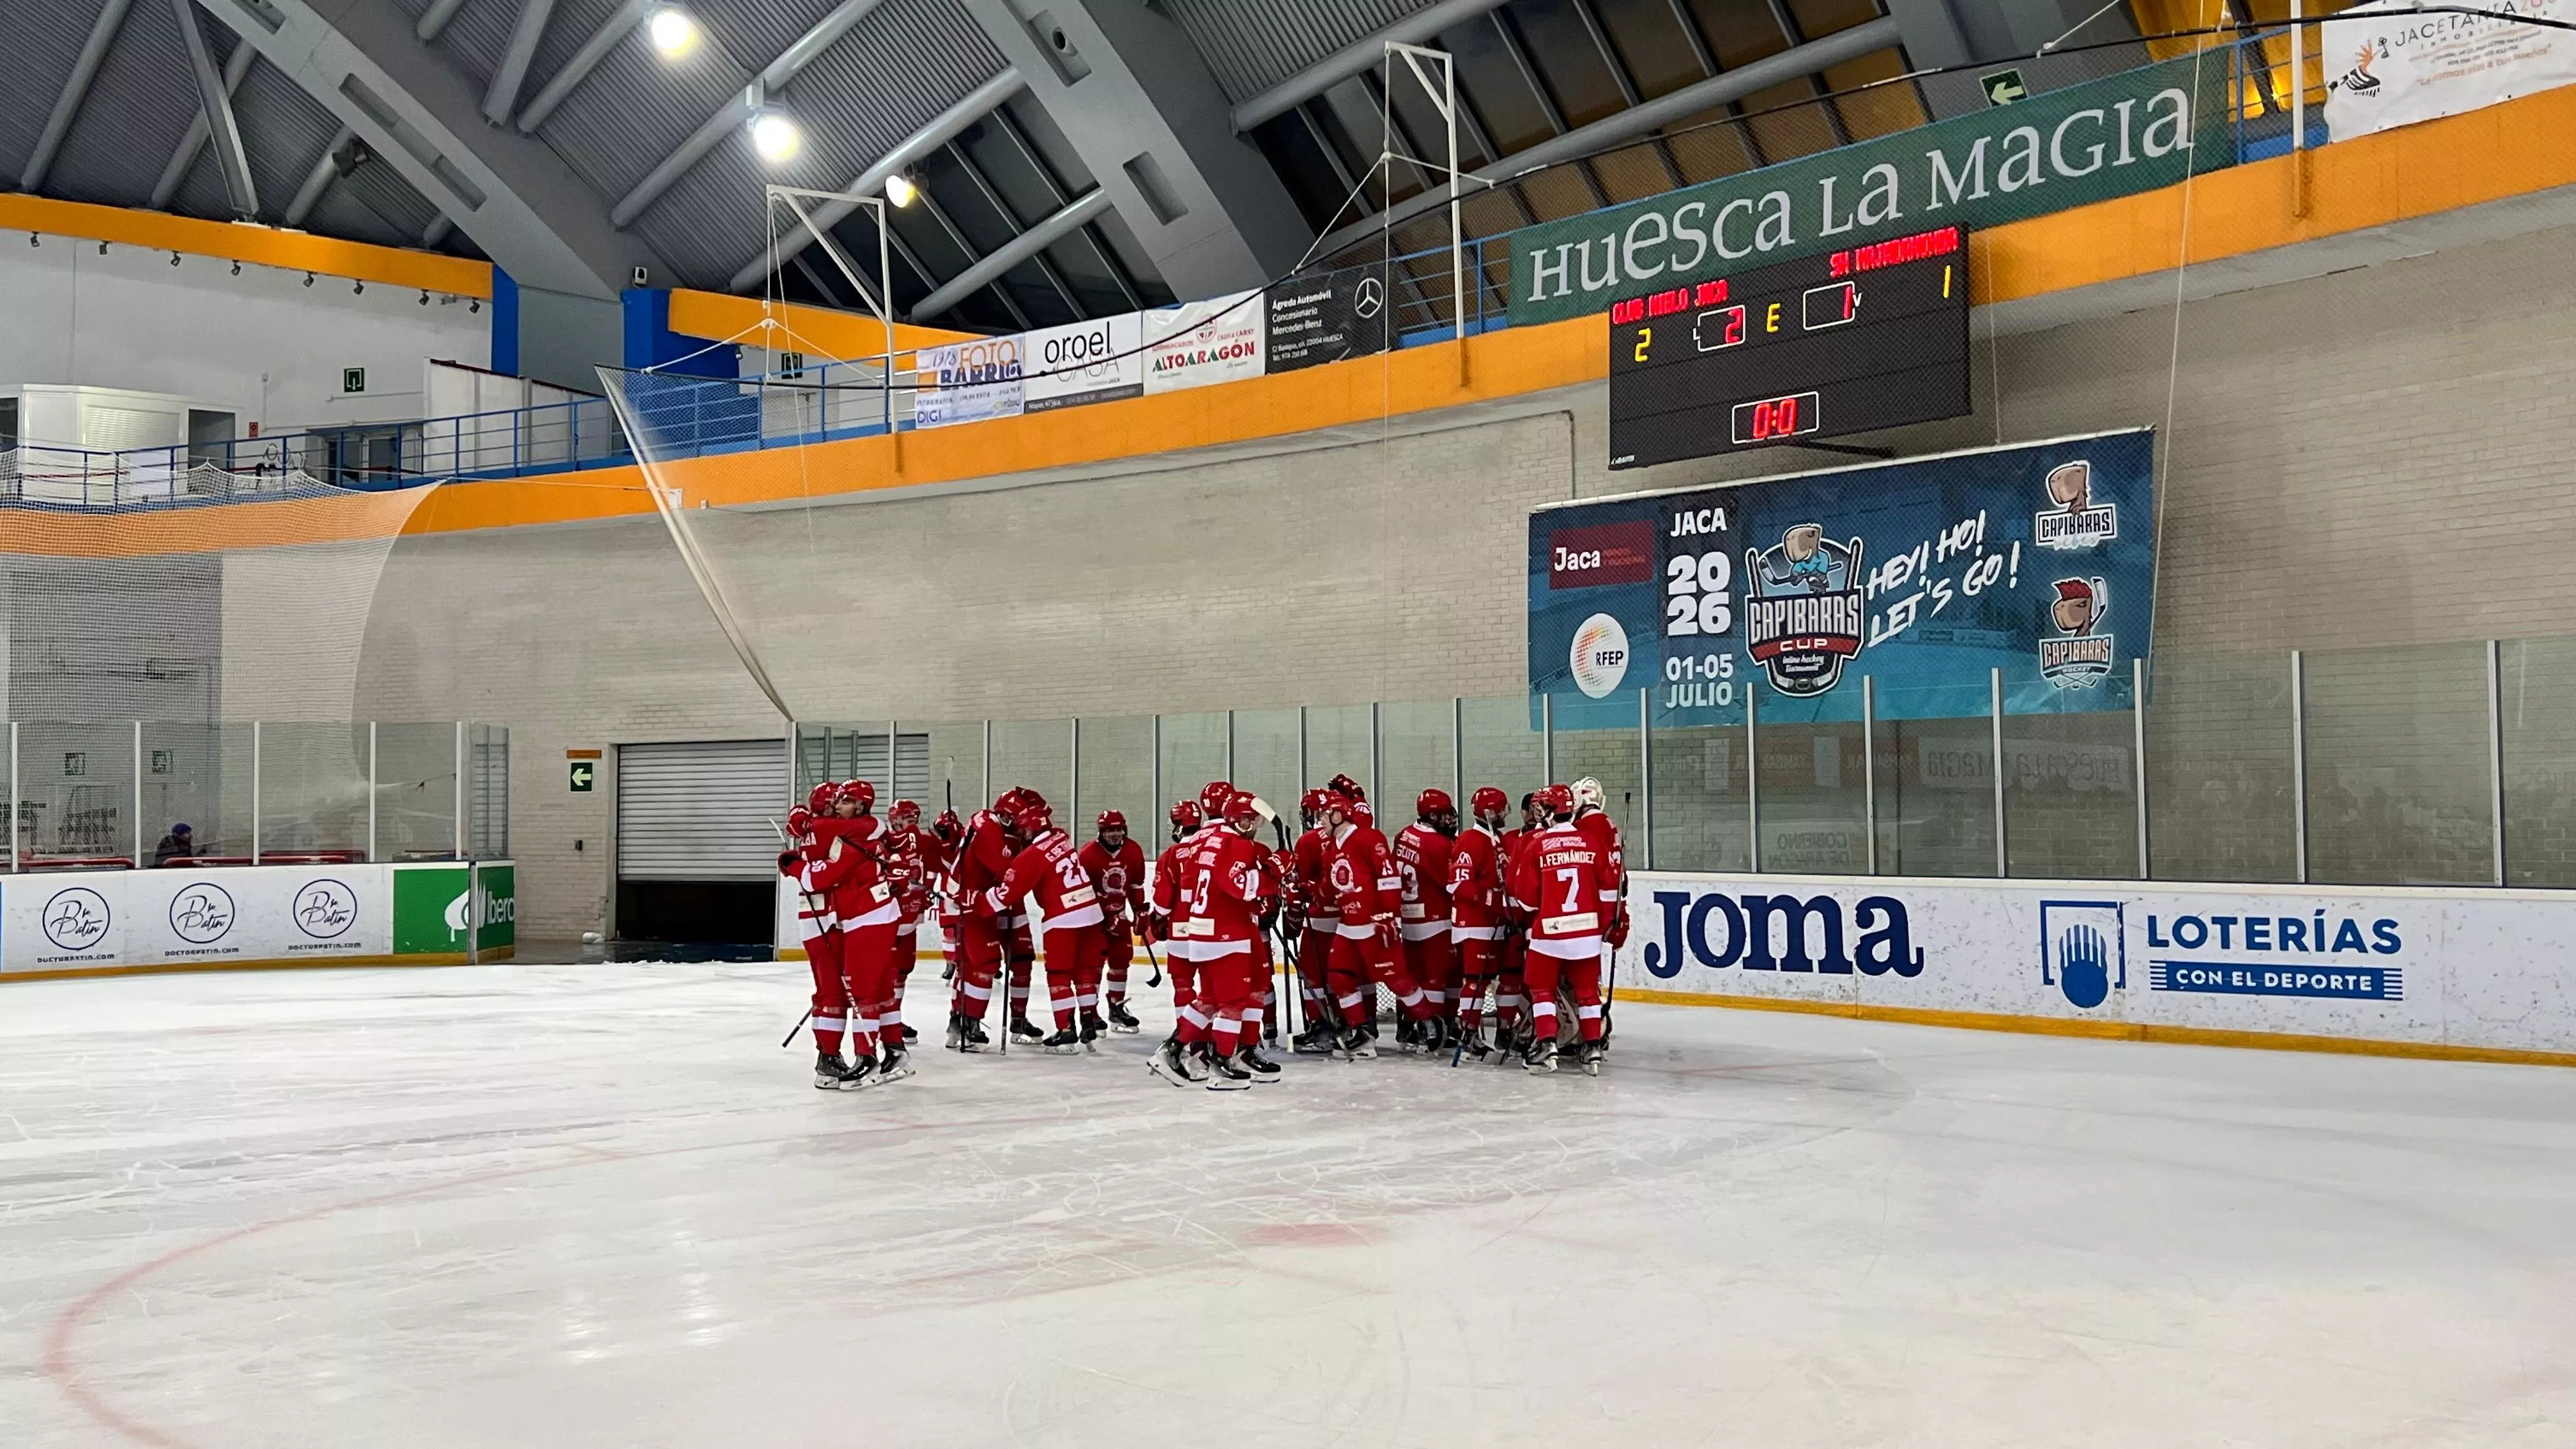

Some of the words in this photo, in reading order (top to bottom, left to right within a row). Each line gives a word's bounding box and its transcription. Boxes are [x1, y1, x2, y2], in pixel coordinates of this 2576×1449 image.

[1819, 164, 1903, 236] La
[1298, 289, 1331, 305] Automóvil
[1943, 264, 1951, 299] 1
[1272, 307, 1318, 323] Concesionario
[1766, 303, 1781, 333] E
[1843, 286, 1852, 319] 1
[1045, 321, 1110, 363] oroel
[1725, 307, 1743, 344] 2
[960, 341, 1015, 371] FOTO
[1153, 339, 1255, 372] ALTOARAGÓN
[1634, 328, 1652, 362] 2
[1057, 348, 1119, 382] CASA
[917, 410, 942, 423] DIGI
[1752, 397, 1797, 440] 0:0
[1670, 507, 1728, 537] JACA
[2042, 511, 2110, 538] CAPIBARAS
[1554, 547, 1600, 571] Jaca
[1866, 540, 1929, 601] HEY!
[1935, 509, 1986, 563] HO!
[1667, 551, 1731, 595] 20
[1667, 592, 1731, 636] 26
[1749, 594, 1859, 645] CAPIBARAS
[1867, 578, 1953, 648] LET'S
[1596, 650, 1623, 666] RFEP
[1780, 639, 1828, 652] CUP
[2043, 638, 2110, 668] CAPIBARAS
[1666, 653, 1733, 681] 01-05
[1666, 682, 1732, 709] JULIO
[1455, 868, 1470, 882] 15
[1556, 868, 1579, 913] 7
[1644, 891, 1924, 979] Joma
[2147, 908, 2402, 954] LOTERÍAS
[2176, 969, 2223, 986] CON
[2232, 970, 2257, 987] EL
[2265, 972, 2373, 992] DEPORTE
